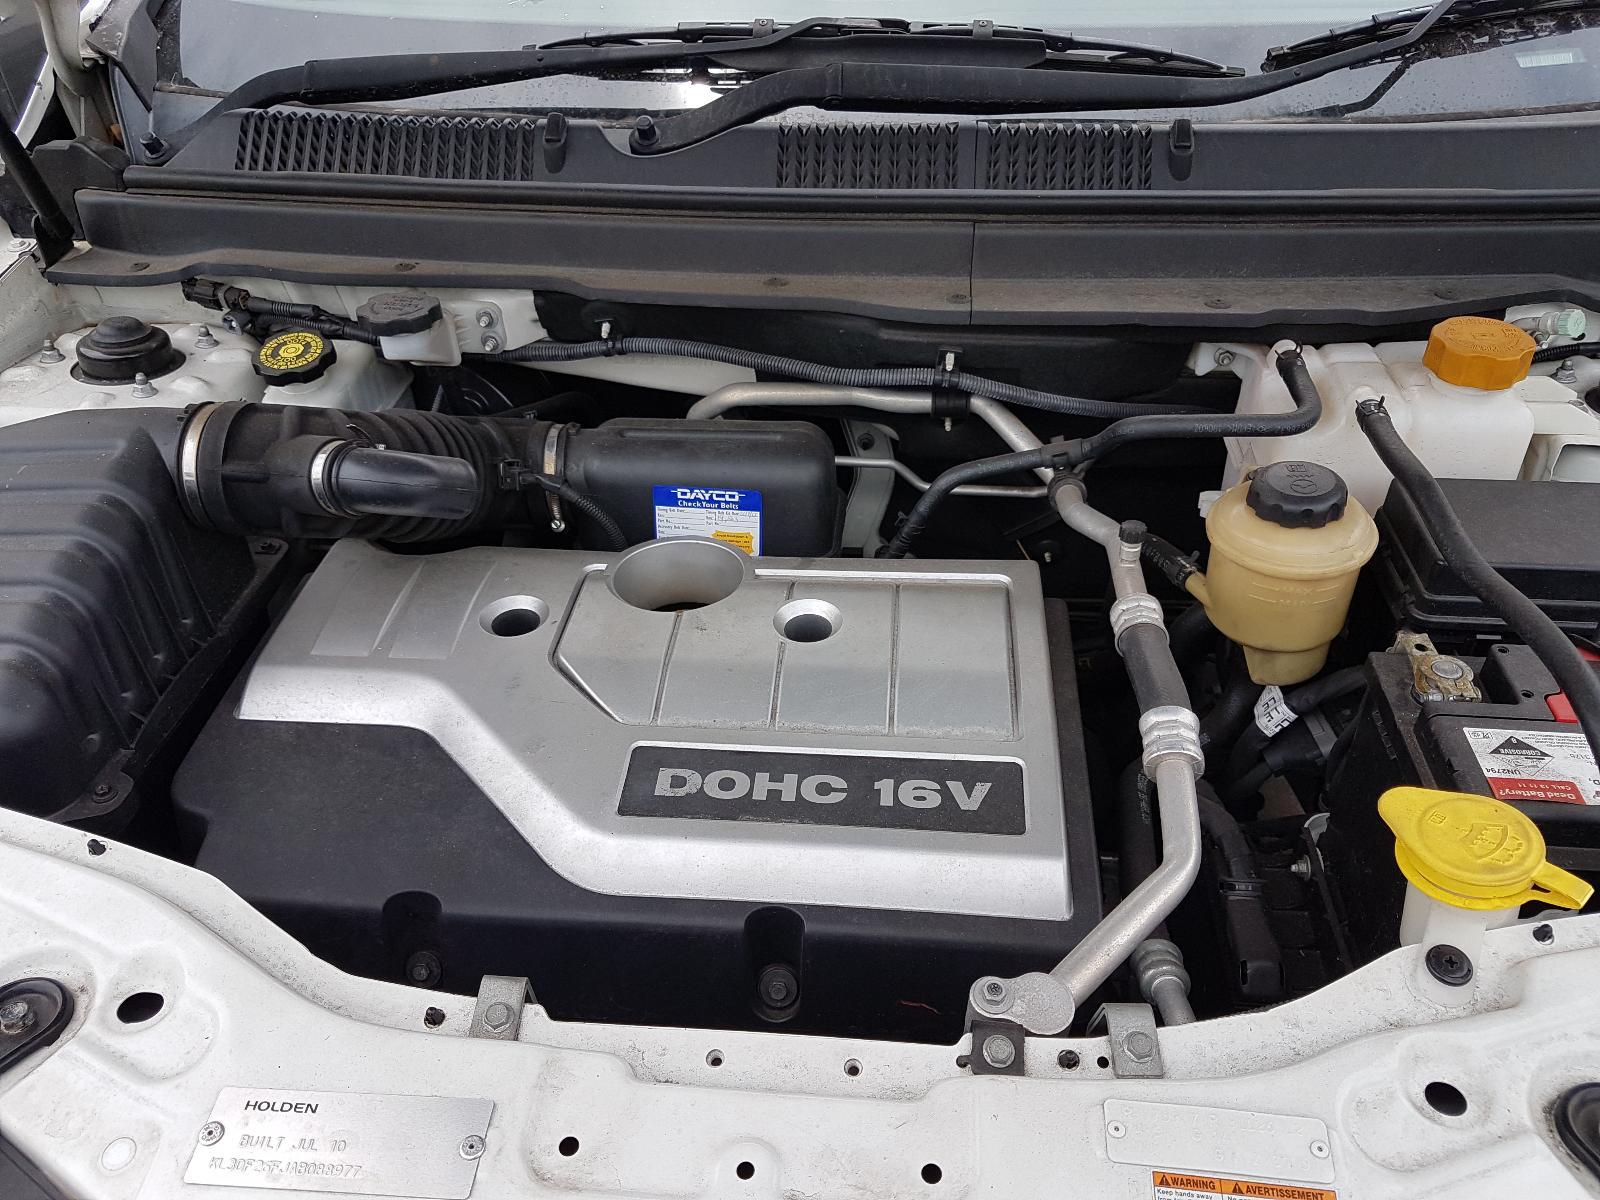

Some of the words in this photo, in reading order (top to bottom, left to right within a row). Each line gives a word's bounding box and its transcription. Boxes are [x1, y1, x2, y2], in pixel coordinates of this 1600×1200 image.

[677, 488, 739, 502] DAYCO
[678, 500, 701, 508] Check
[1499, 748, 1541, 756] CORROSIVE
[1485, 767, 1521, 776] UN2794
[654, 767, 848, 804] DOHC
[873, 777, 992, 811] 16V
[1499, 788, 1546, 799] Battery?
[1547, 791, 1576, 800] Dead
[244, 1100, 319, 1114] HOLDEN
[240, 1134, 286, 1149] BUILT
[292, 1138, 318, 1151] JUL
[331, 1138, 347, 1152] 10
[1170, 1176, 1216, 1191] WARNING
[1157, 1188, 1173, 1196] Keep
[1175, 1190, 1195, 1198] hands
[1246, 1185, 1324, 1200] AVERTISSEMENT
